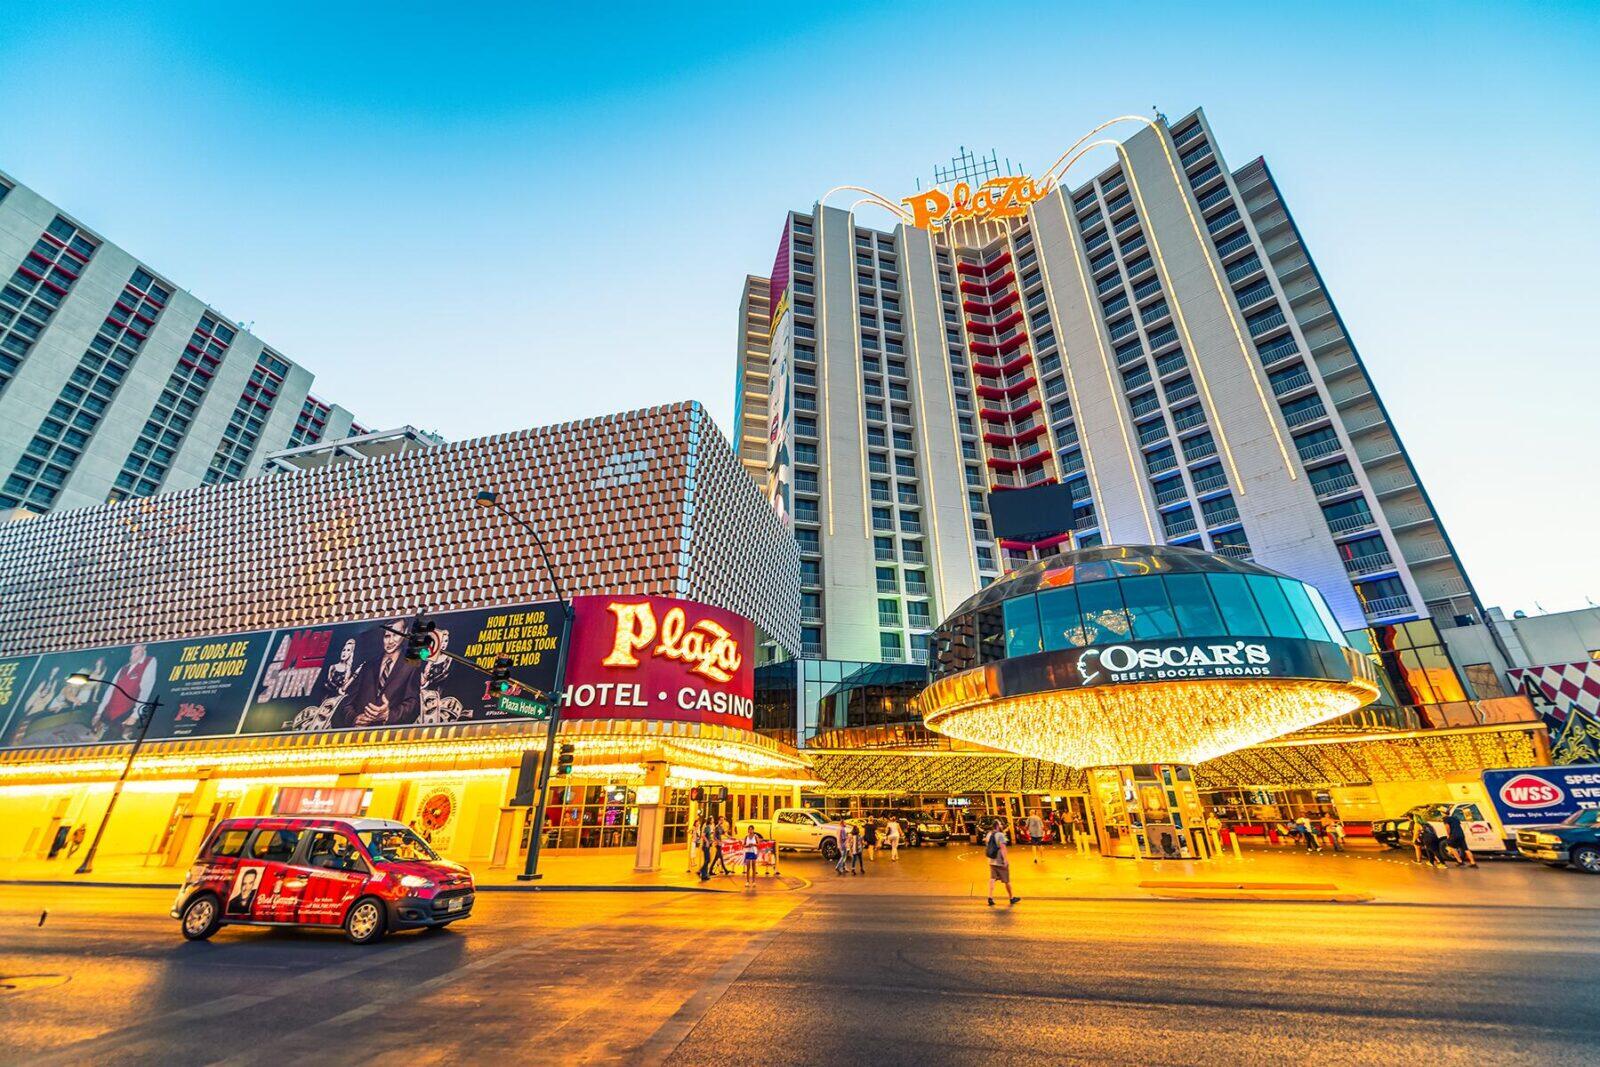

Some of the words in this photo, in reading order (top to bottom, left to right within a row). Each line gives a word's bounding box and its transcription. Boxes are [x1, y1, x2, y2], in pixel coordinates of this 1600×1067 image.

[901, 176, 1048, 233] Plaza
[486, 614, 508, 628] HOW
[508, 613, 525, 626] THE
[525, 611, 545, 625] MOB
[478, 628, 503, 643] MADE
[503, 627, 520, 640] LAS
[521, 624, 549, 639] VEGAS
[602, 602, 742, 682] Plaza
[180, 646, 201, 662] THE
[199, 643, 228, 660] ODDS
[226, 641, 249, 658] ARE
[464, 643, 483, 657] AND
[483, 641, 505, 655] HOW
[505, 639, 533, 653] VEGAS
[534, 636, 558, 651] TOOK
[1099, 641, 1271, 672] OSCAR'S
[168, 665, 184, 681] IN
[182, 663, 210, 680] YOUR
[208, 659, 248, 678] FAVOR!
[476, 656, 497, 670] DOW
[520, 652, 541, 667] MOB
[1111, 672, 1145, 682] BEEF
[1157, 669, 1206, 678] BOOZE
[1215, 667, 1271, 676] BROADS
[500, 697, 519, 711] Plaza
[520, 701, 537, 715] Hotel
[678, 688, 754, 719] CASINO
[1509, 786, 1554, 801] WSS
[1576, 801, 1600, 811] TE
